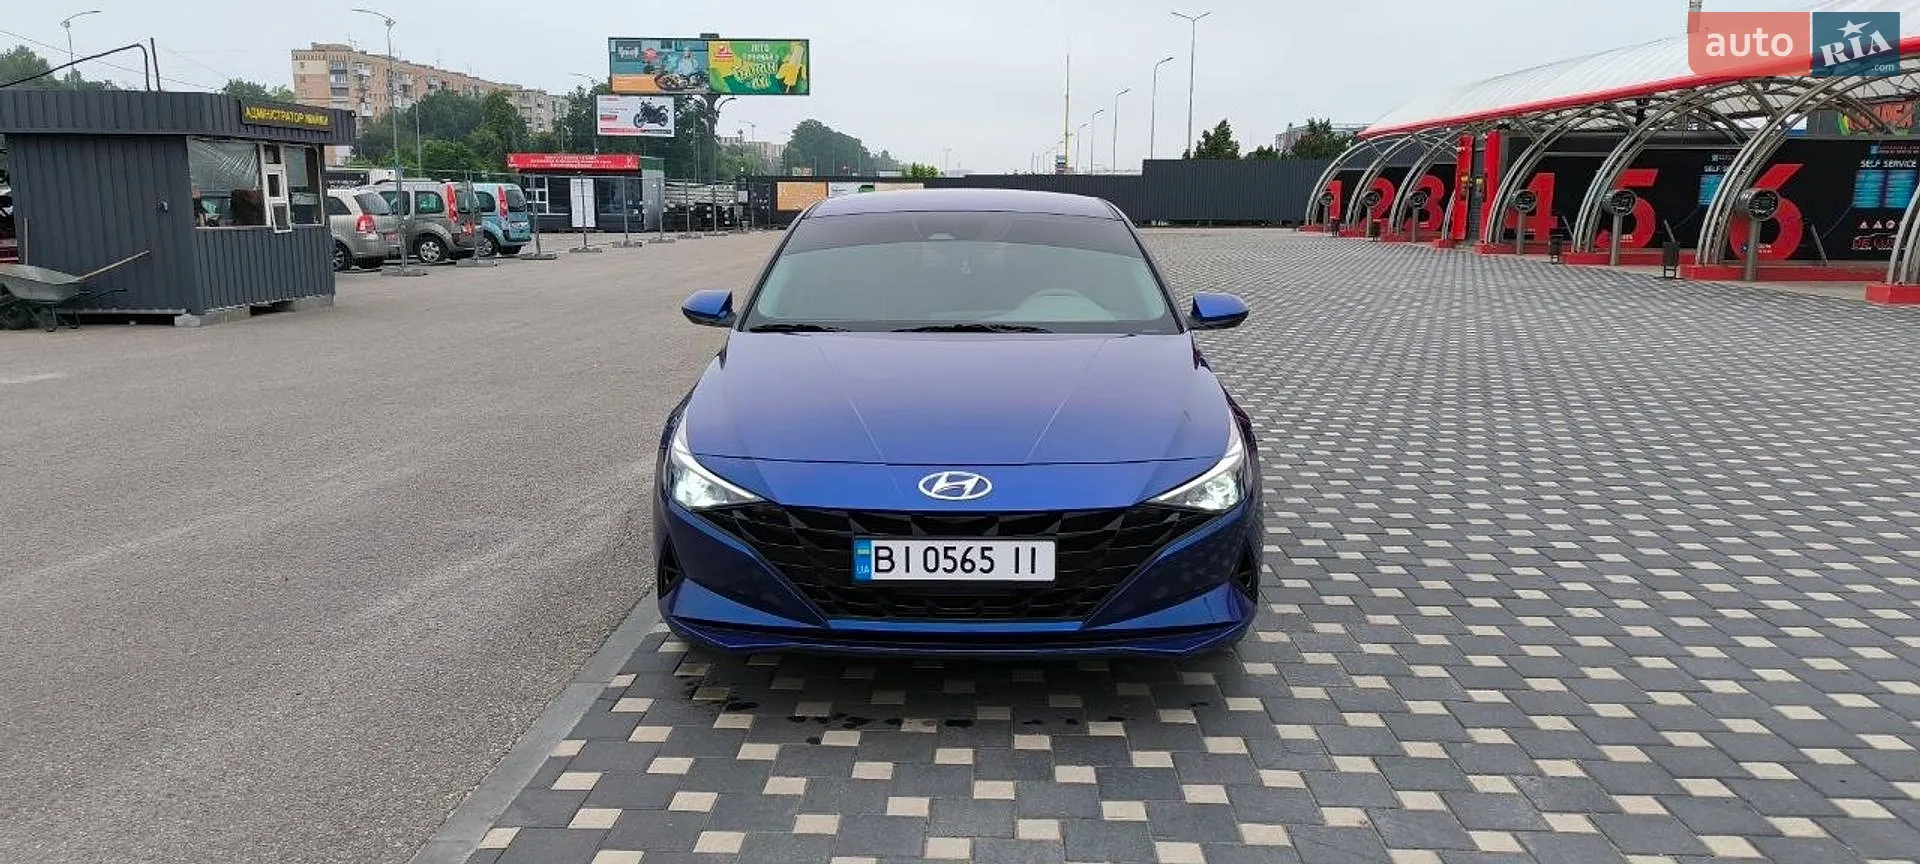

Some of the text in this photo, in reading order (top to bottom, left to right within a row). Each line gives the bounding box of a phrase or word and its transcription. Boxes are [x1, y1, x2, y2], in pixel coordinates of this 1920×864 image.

[1860, 160, 1917, 168] SELF SERVICE
[1504, 172, 1558, 242] 4
[1595, 168, 1659, 250] 5
[1730, 164, 1803, 261] 6
[874, 546, 1037, 574] BI 0565 II
